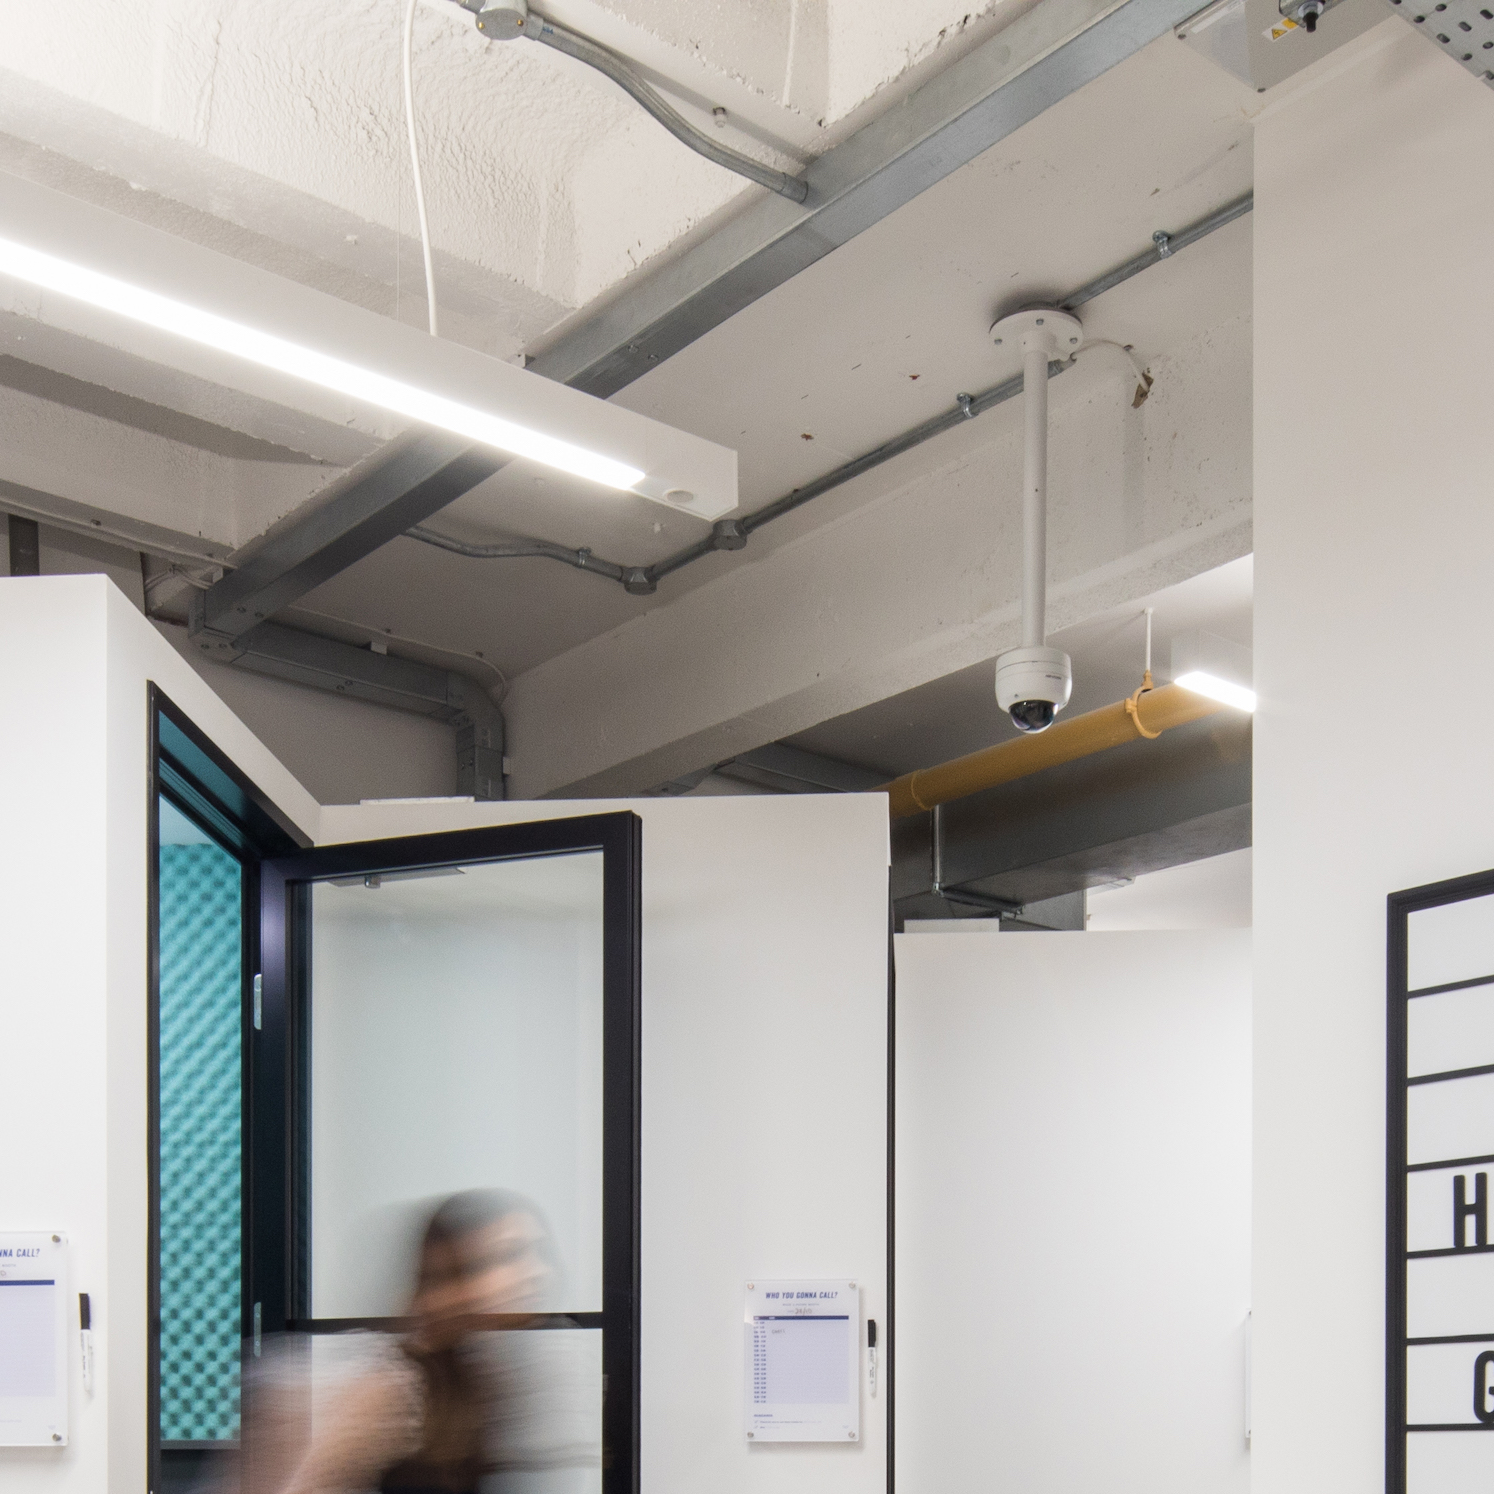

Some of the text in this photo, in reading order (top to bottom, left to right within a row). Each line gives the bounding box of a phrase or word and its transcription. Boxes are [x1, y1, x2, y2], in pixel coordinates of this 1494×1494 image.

[16, 1248, 41, 1258] CALL?
[796, 1291, 817, 1299] GONNA
[819, 1291, 838, 1299] CALL?
